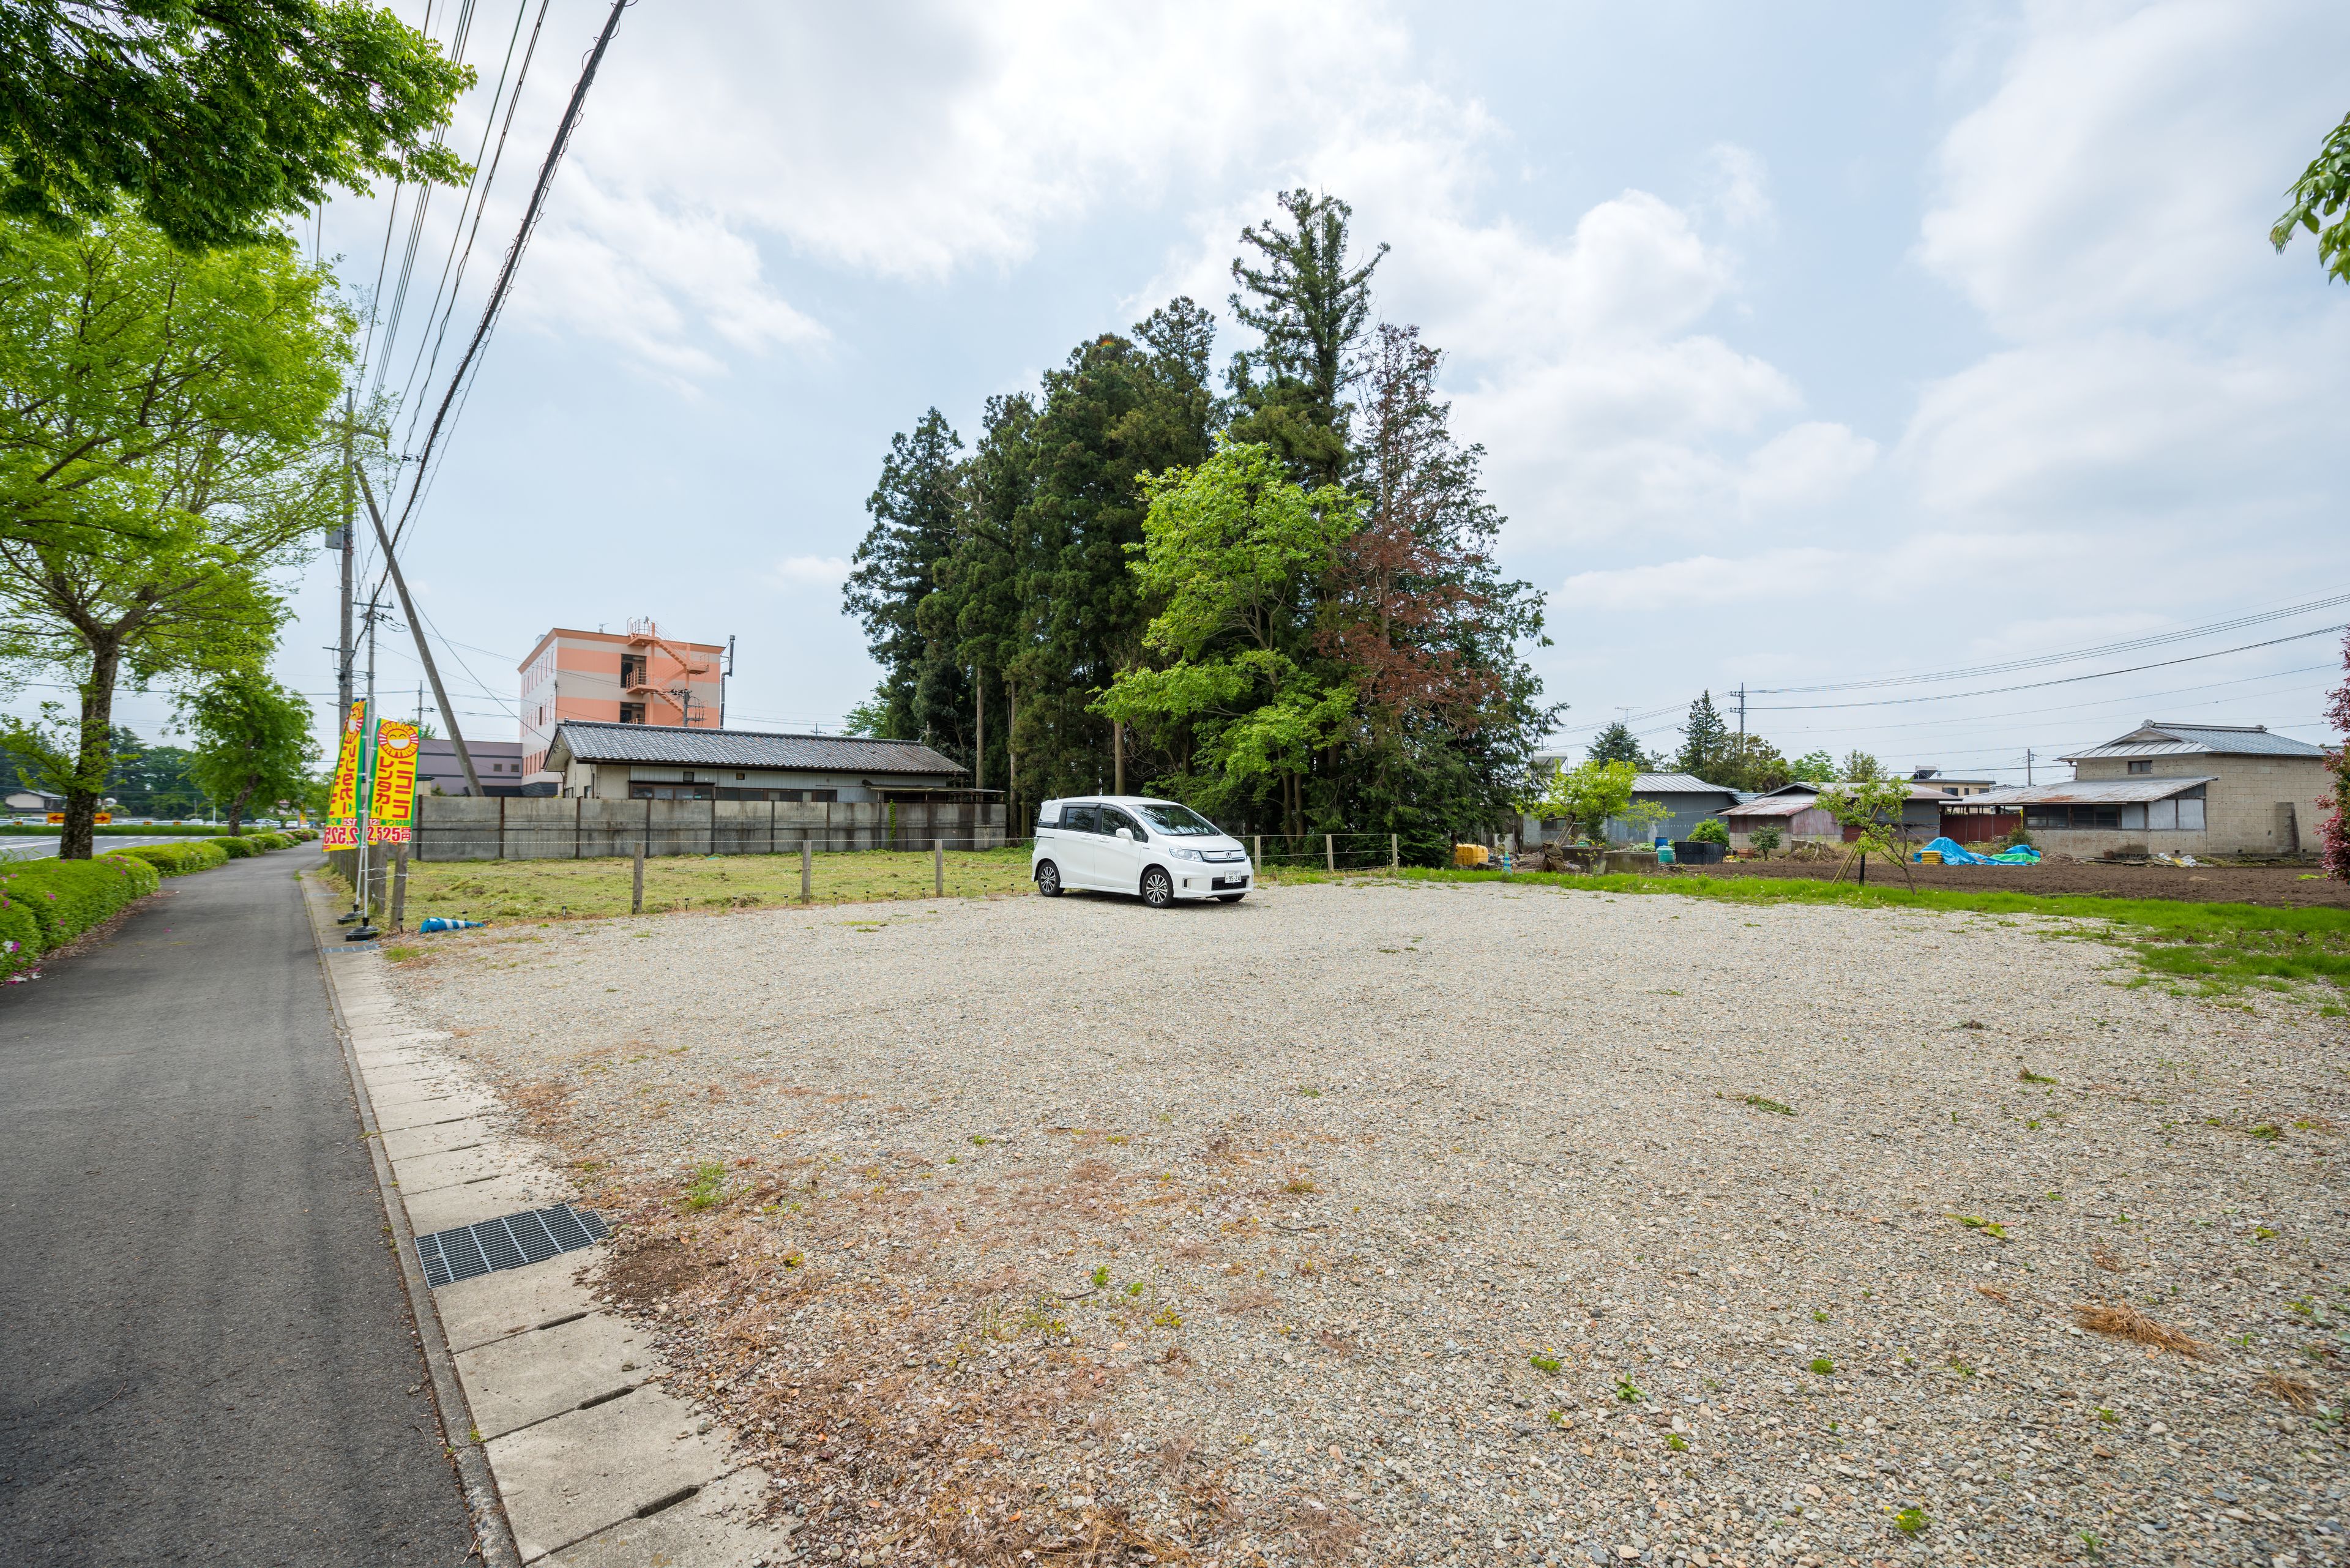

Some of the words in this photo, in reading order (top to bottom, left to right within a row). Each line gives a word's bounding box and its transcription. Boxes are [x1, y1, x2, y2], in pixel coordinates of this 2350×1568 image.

[375, 756, 394, 816] レンタカー
[392, 761, 414, 819] ニコニコ
